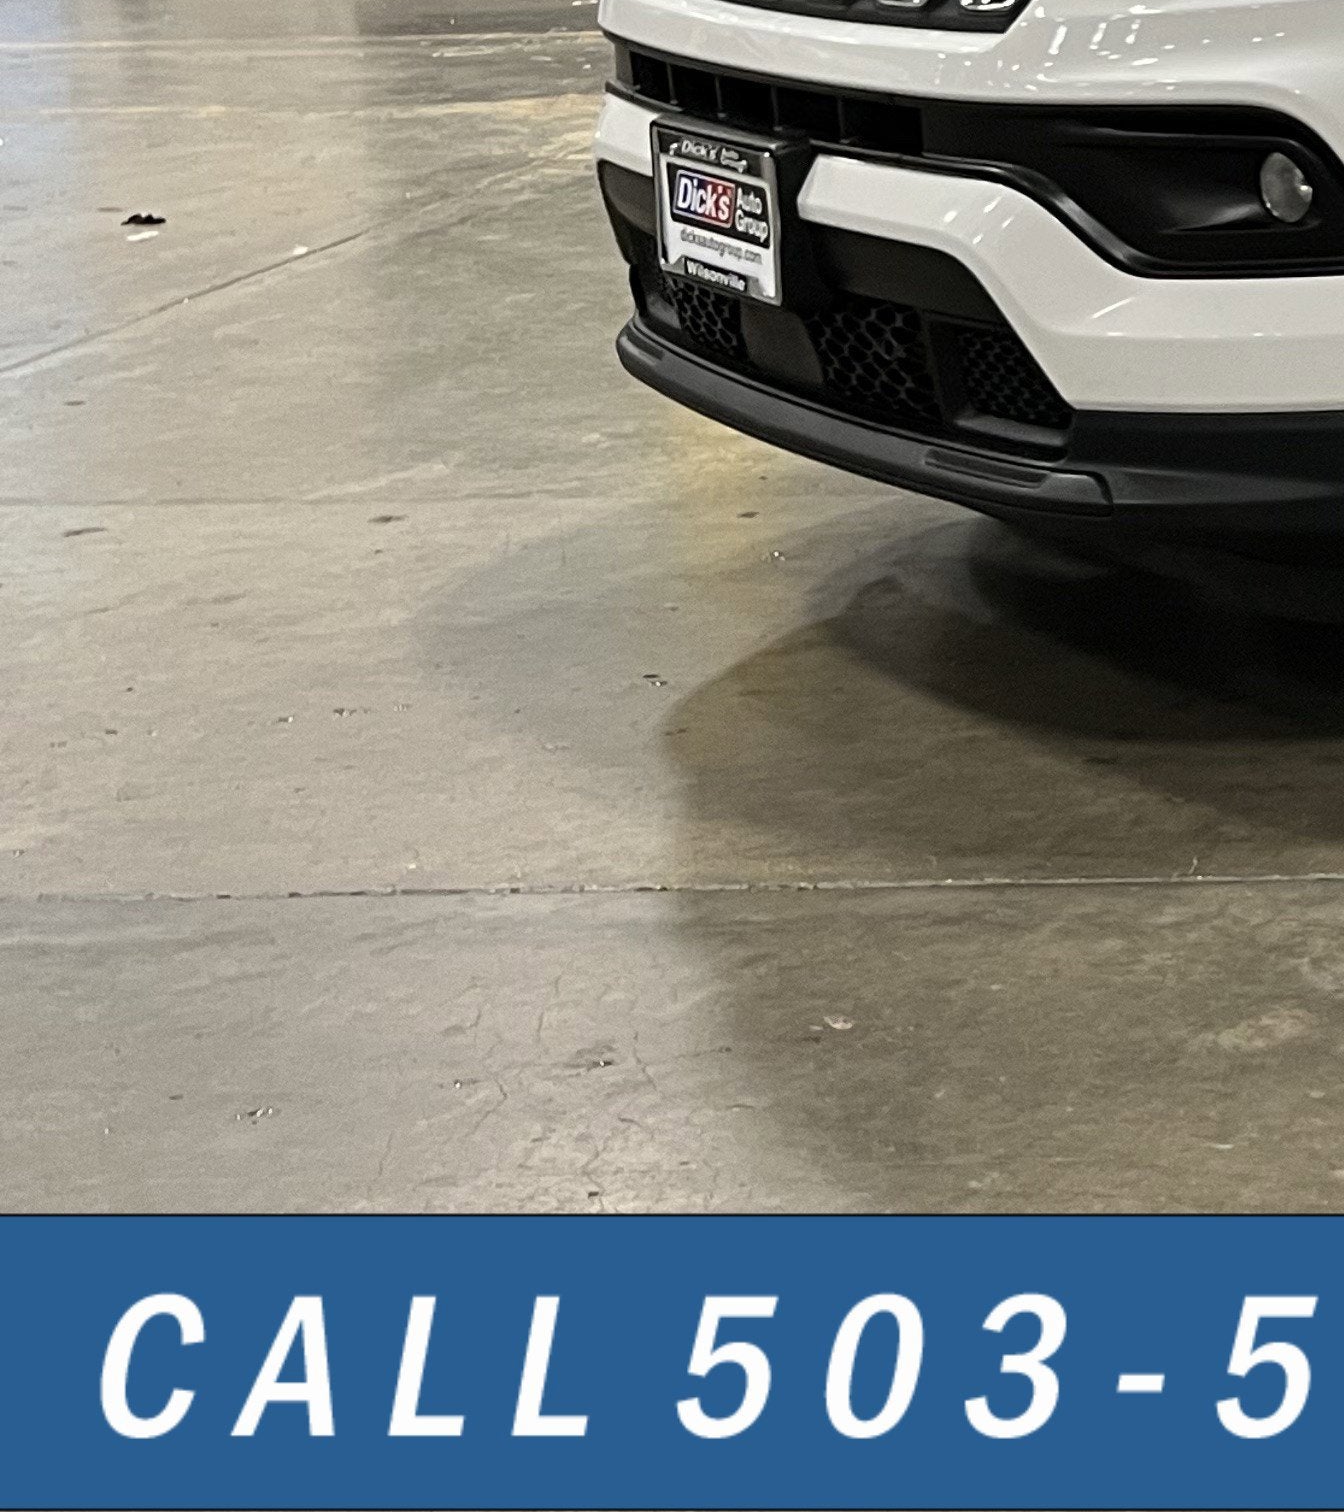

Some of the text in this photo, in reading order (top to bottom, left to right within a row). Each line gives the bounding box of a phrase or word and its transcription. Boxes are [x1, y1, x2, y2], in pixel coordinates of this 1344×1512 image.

[677, 176, 731, 221] Dick's
[736, 187, 763, 215] Auto
[734, 209, 769, 244] Group
